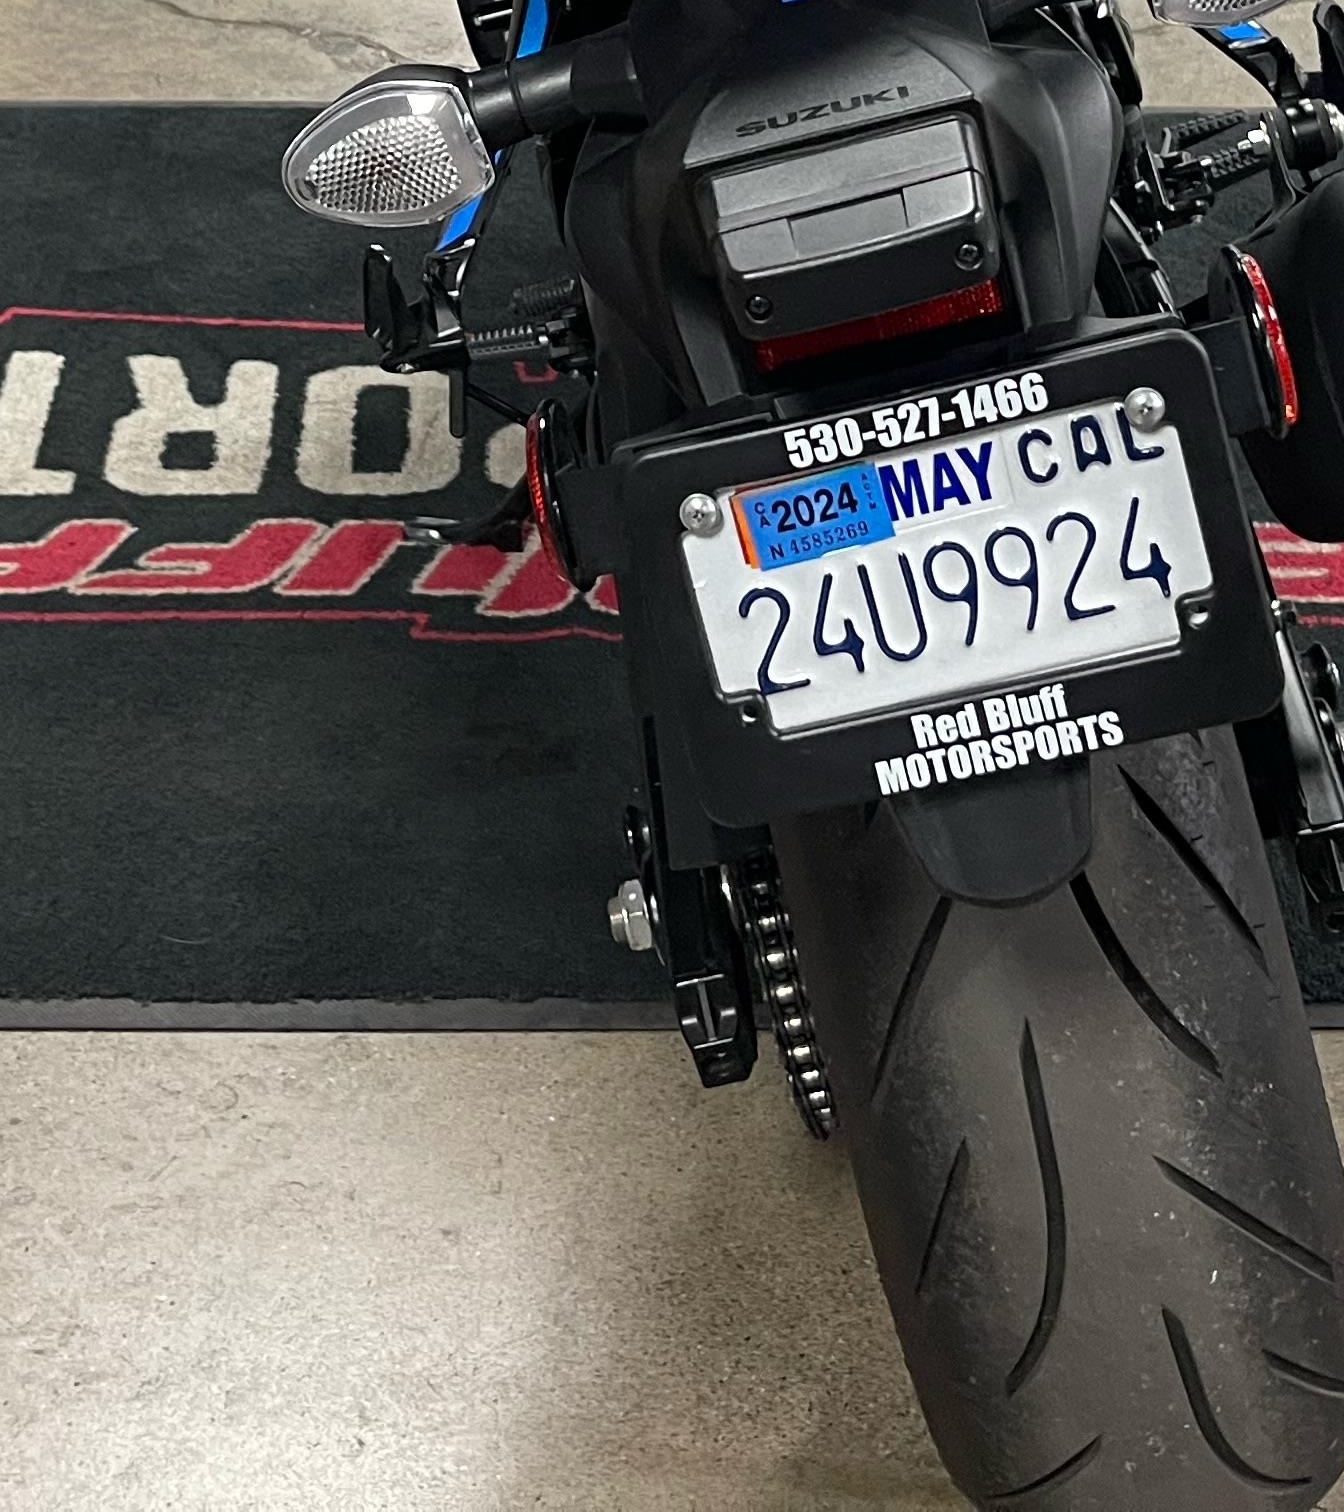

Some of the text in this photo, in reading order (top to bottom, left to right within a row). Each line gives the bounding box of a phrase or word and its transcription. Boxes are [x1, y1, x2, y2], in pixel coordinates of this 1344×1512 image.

[734, 85, 911, 139] SUZUKI
[783, 372, 1050, 470] 530-527-1466
[1017, 403, 1165, 484] CAL
[771, 482, 858, 534] 2024
[877, 441, 994, 522] MAY
[789, 520, 869, 555] 4585269
[738, 497, 1172, 696] 24U9924
[874, 710, 1125, 796] MOTORSPORTS
[910, 683, 1069, 749] Red Bluff
